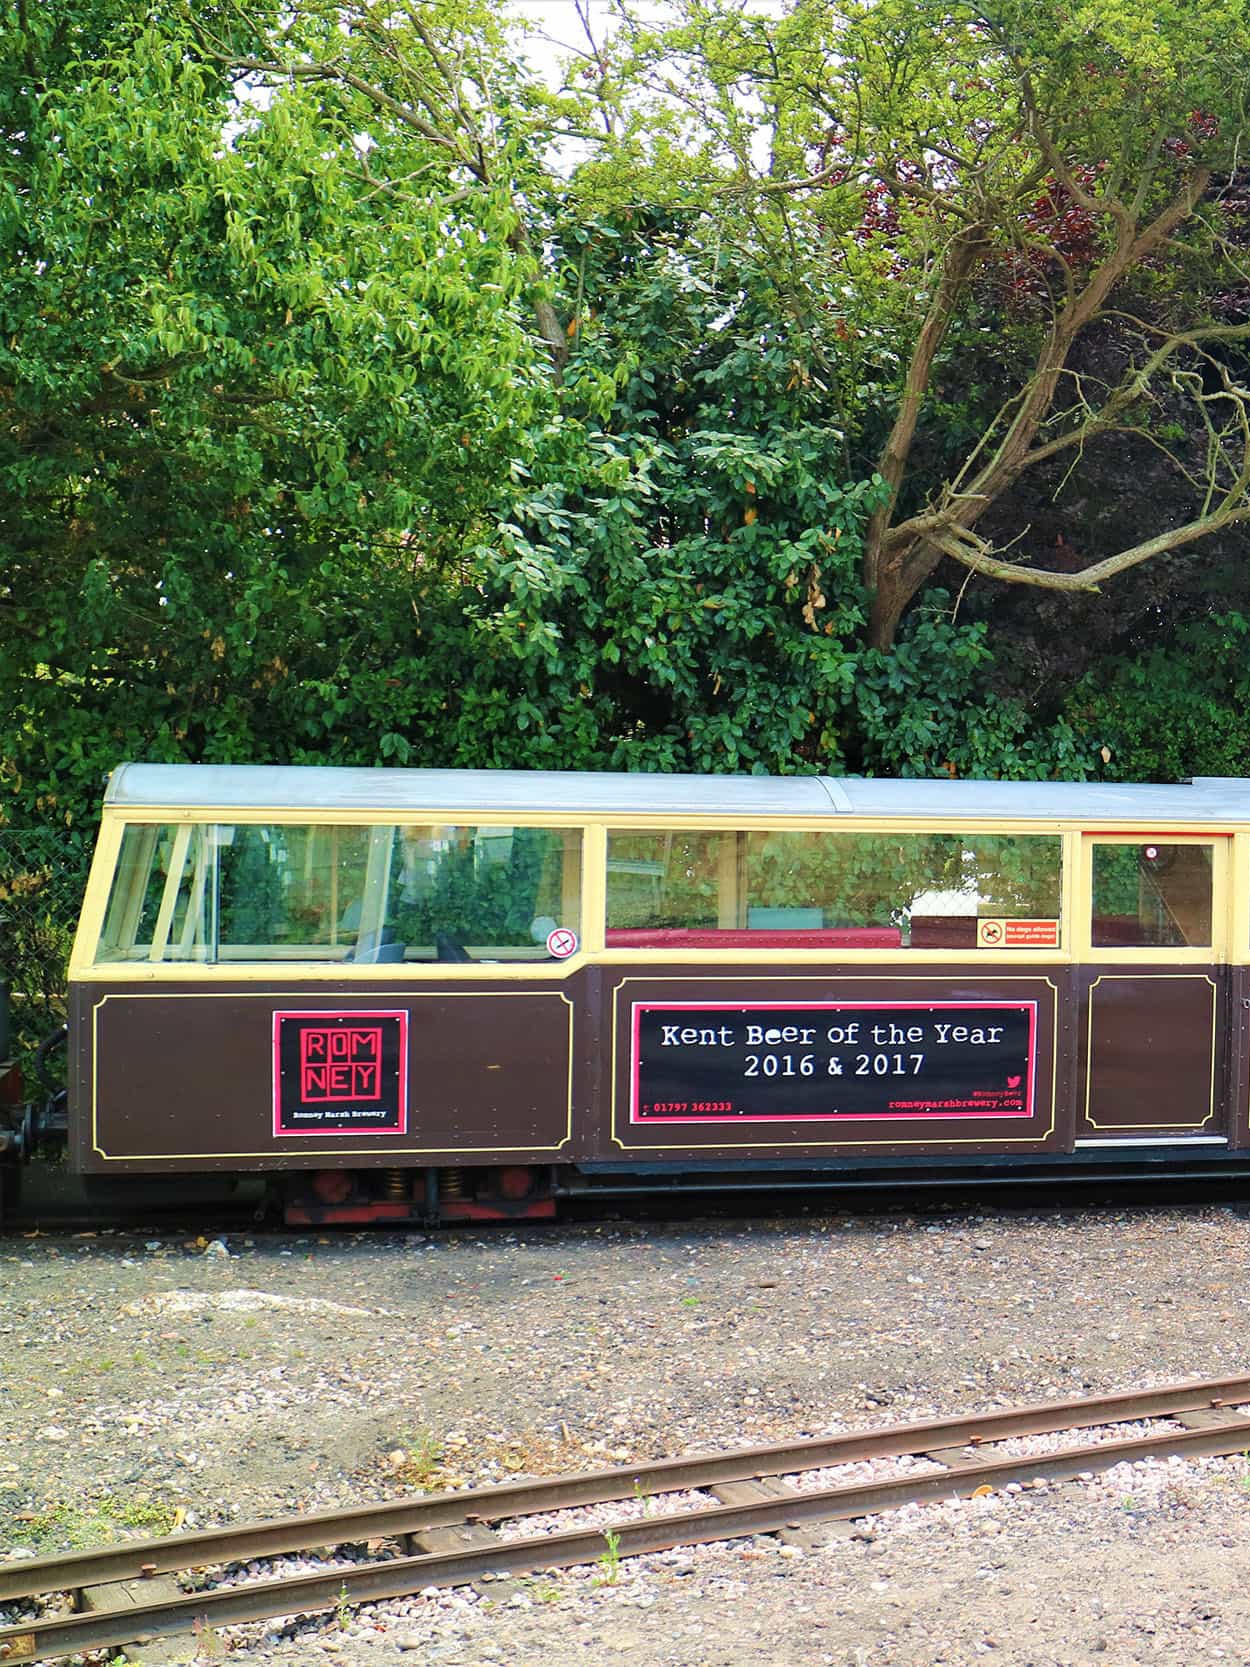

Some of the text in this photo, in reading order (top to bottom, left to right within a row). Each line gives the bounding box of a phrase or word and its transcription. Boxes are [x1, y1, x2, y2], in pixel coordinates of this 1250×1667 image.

[307, 1033, 377, 1057] ROM
[661, 1023, 1004, 1046] Kent Beer of the Year
[744, 1054, 925, 1076] 2016 & 2017
[306, 1066, 375, 1091] NEY
[653, 1103, 688, 1112] 01797
[691, 1102, 732, 1112] 362333
[888, 1098, 1023, 1110] romneymarshbrewery.com
